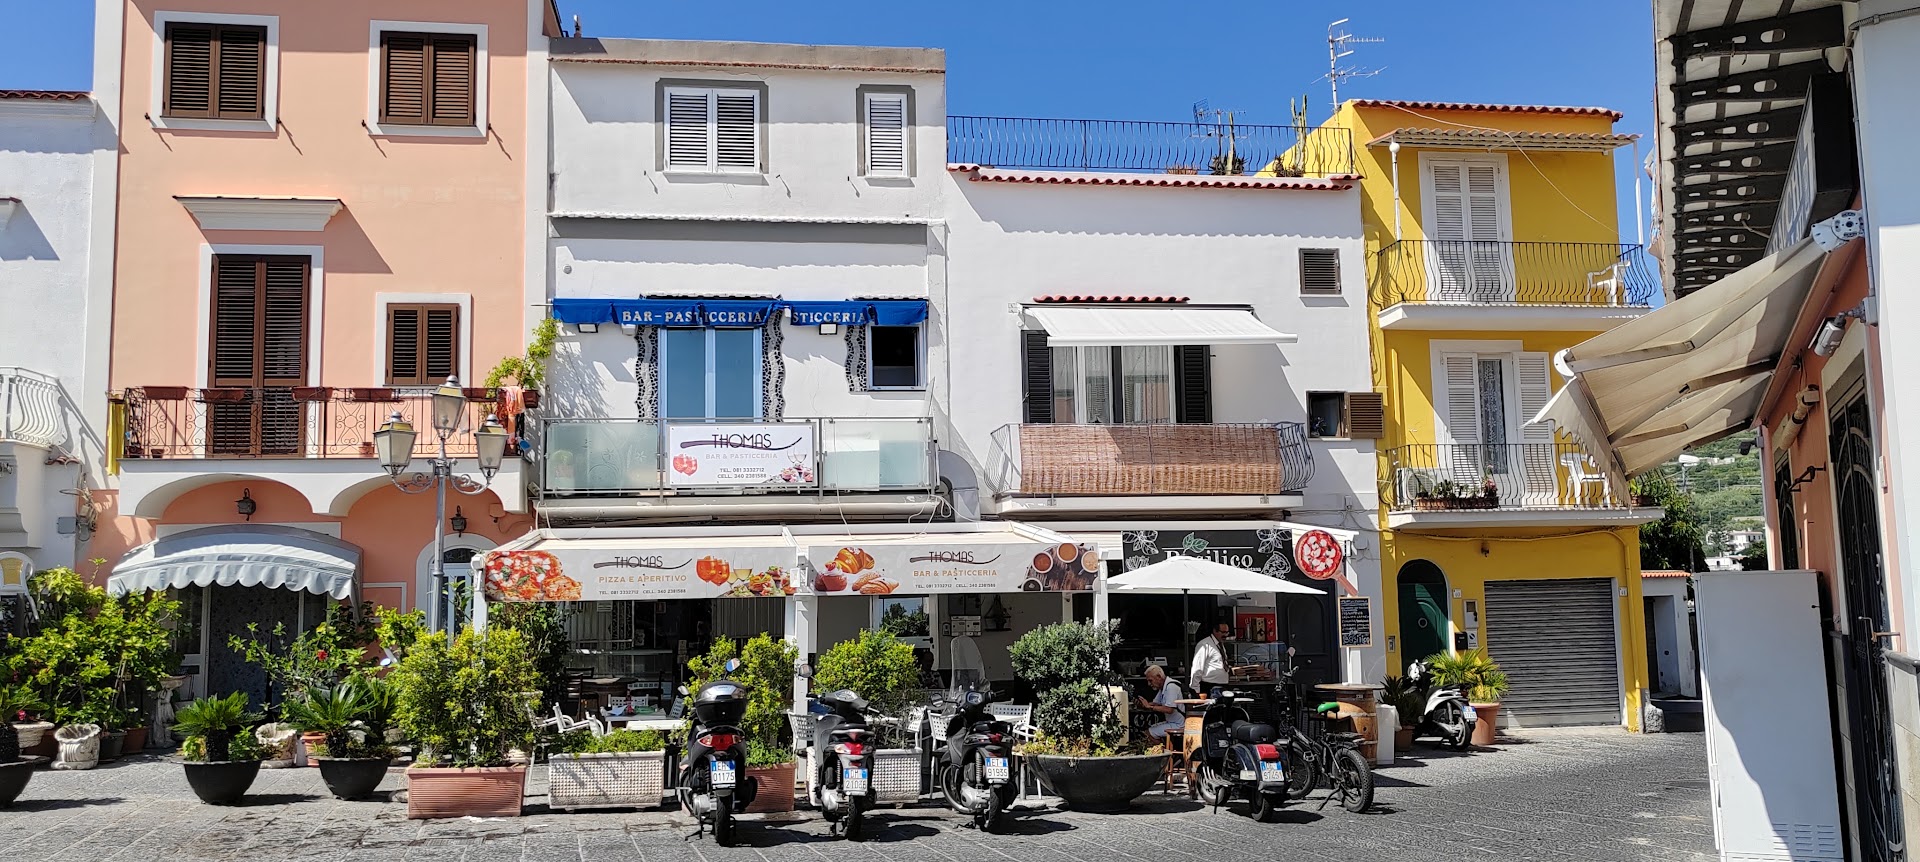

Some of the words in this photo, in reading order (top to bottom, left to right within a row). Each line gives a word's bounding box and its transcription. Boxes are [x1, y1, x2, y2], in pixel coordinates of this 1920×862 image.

[712, 433, 772, 448] THOMAS
[614, 556, 663, 568] THOMAS
[929, 551, 974, 562] THOMAS
[1164, 549, 1253, 568] Bilico
[637, 574, 687, 583] APERITIVO
[942, 569, 997, 577] PASTICCERIA
[713, 772, 735, 782] 01175
